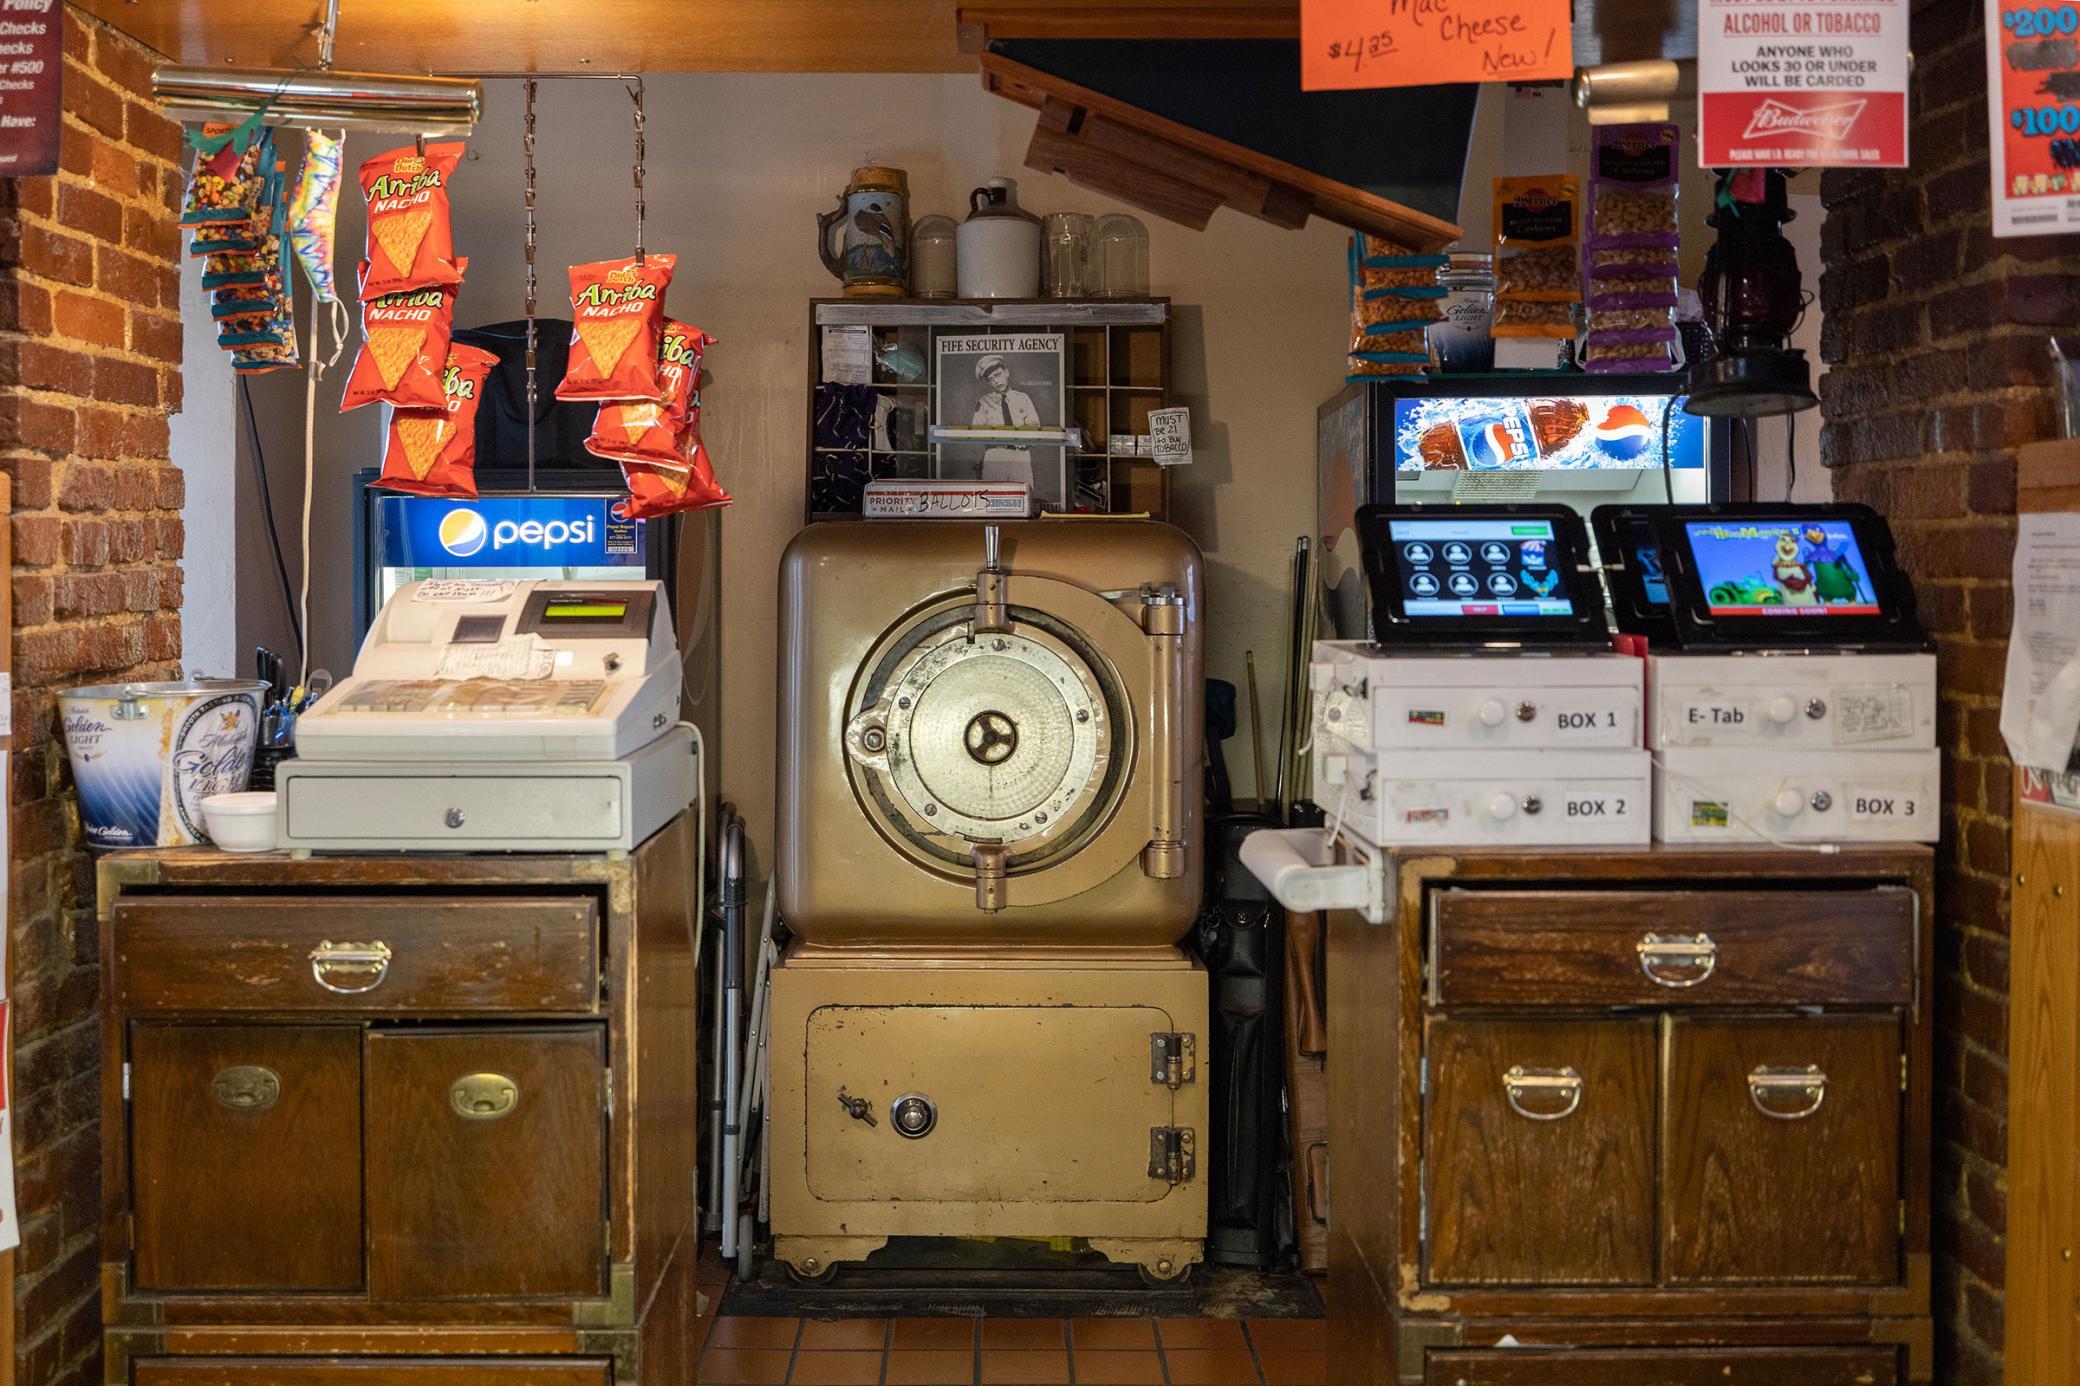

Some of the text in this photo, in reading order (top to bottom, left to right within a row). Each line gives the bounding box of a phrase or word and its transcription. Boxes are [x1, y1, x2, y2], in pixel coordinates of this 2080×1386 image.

[3, 0, 51, 13] Policy
[0, 22, 47, 35] Checks
[1440, 14, 1527, 44] Cheese
[1723, 13, 1881, 33] ALCOHOL OR TOBACCO
[2003, 6, 2079, 38] $200
[1756, 46, 1854, 58] ANYONE WHO
[11, 60, 44, 74] #500
[1731, 61, 1878, 73] LOOKS 30 OR UNDER
[1744, 75, 1865, 87] WILL BE CARDED
[1, 115, 37, 128] Have:
[1754, 108, 1855, 129] Budweiser
[2010, 103, 2080, 138] $100
[368, 167, 442, 202] Arriba
[374, 190, 431, 213] NACHO
[575, 280, 657, 307] Arriba
[369, 309, 432, 321] NACHO
[582, 301, 645, 317] NACHO
[941, 338, 1059, 352] FIFE SECURITY AGENCY
[1168, 424, 1178, 435] 21
[1502, 406, 1528, 463] PEPSI
[869, 497, 915, 505] PRIORITY
[918, 489, 992, 513] BALLOTS
[493, 514, 595, 550] pepsi
[1557, 711, 1617, 729] BOX 1
[1711, 707, 1744, 723] Tab
[63, 716, 112, 733] Golden
[1567, 799, 1627, 816] BOX 2
[1855, 798, 1915, 816] BOX 3
